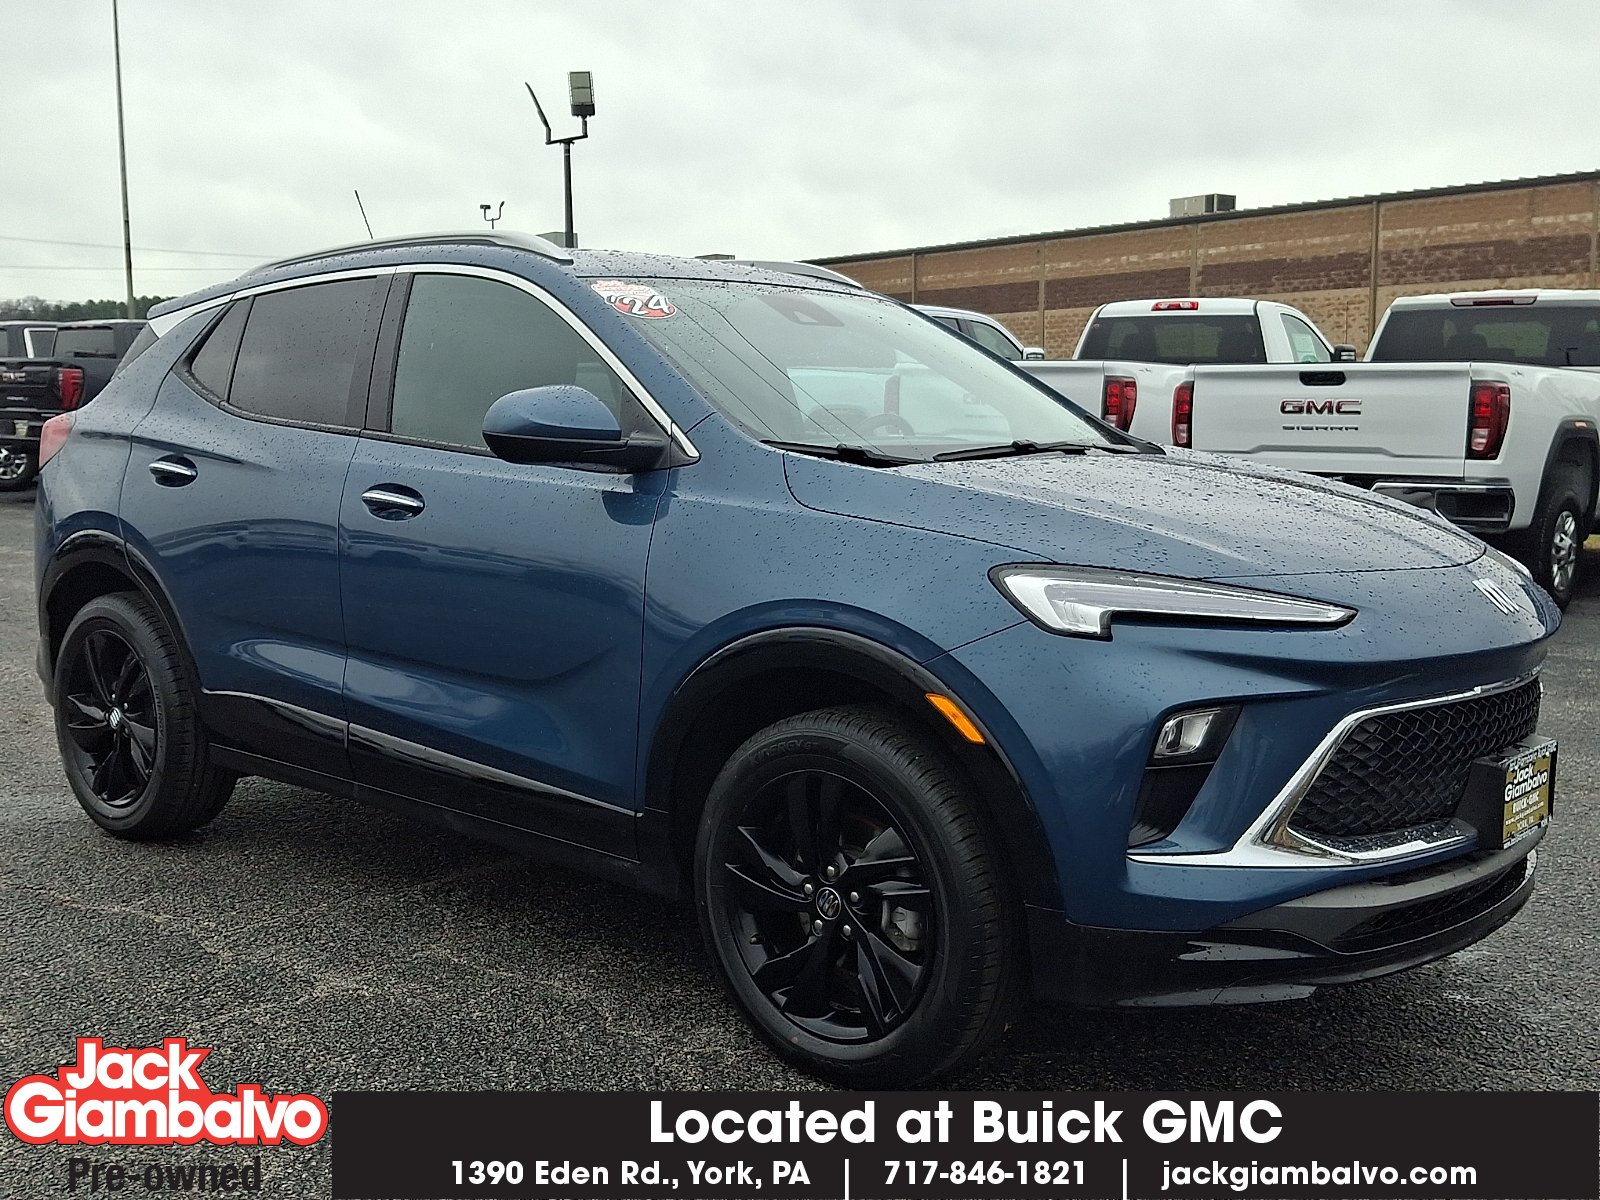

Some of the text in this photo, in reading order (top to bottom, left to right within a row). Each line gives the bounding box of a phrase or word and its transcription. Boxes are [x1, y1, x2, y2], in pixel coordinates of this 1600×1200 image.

[1280, 399, 1361, 415] GMC
[1513, 763, 1535, 784] Jack
[1504, 771, 1548, 802] Giambalvo
